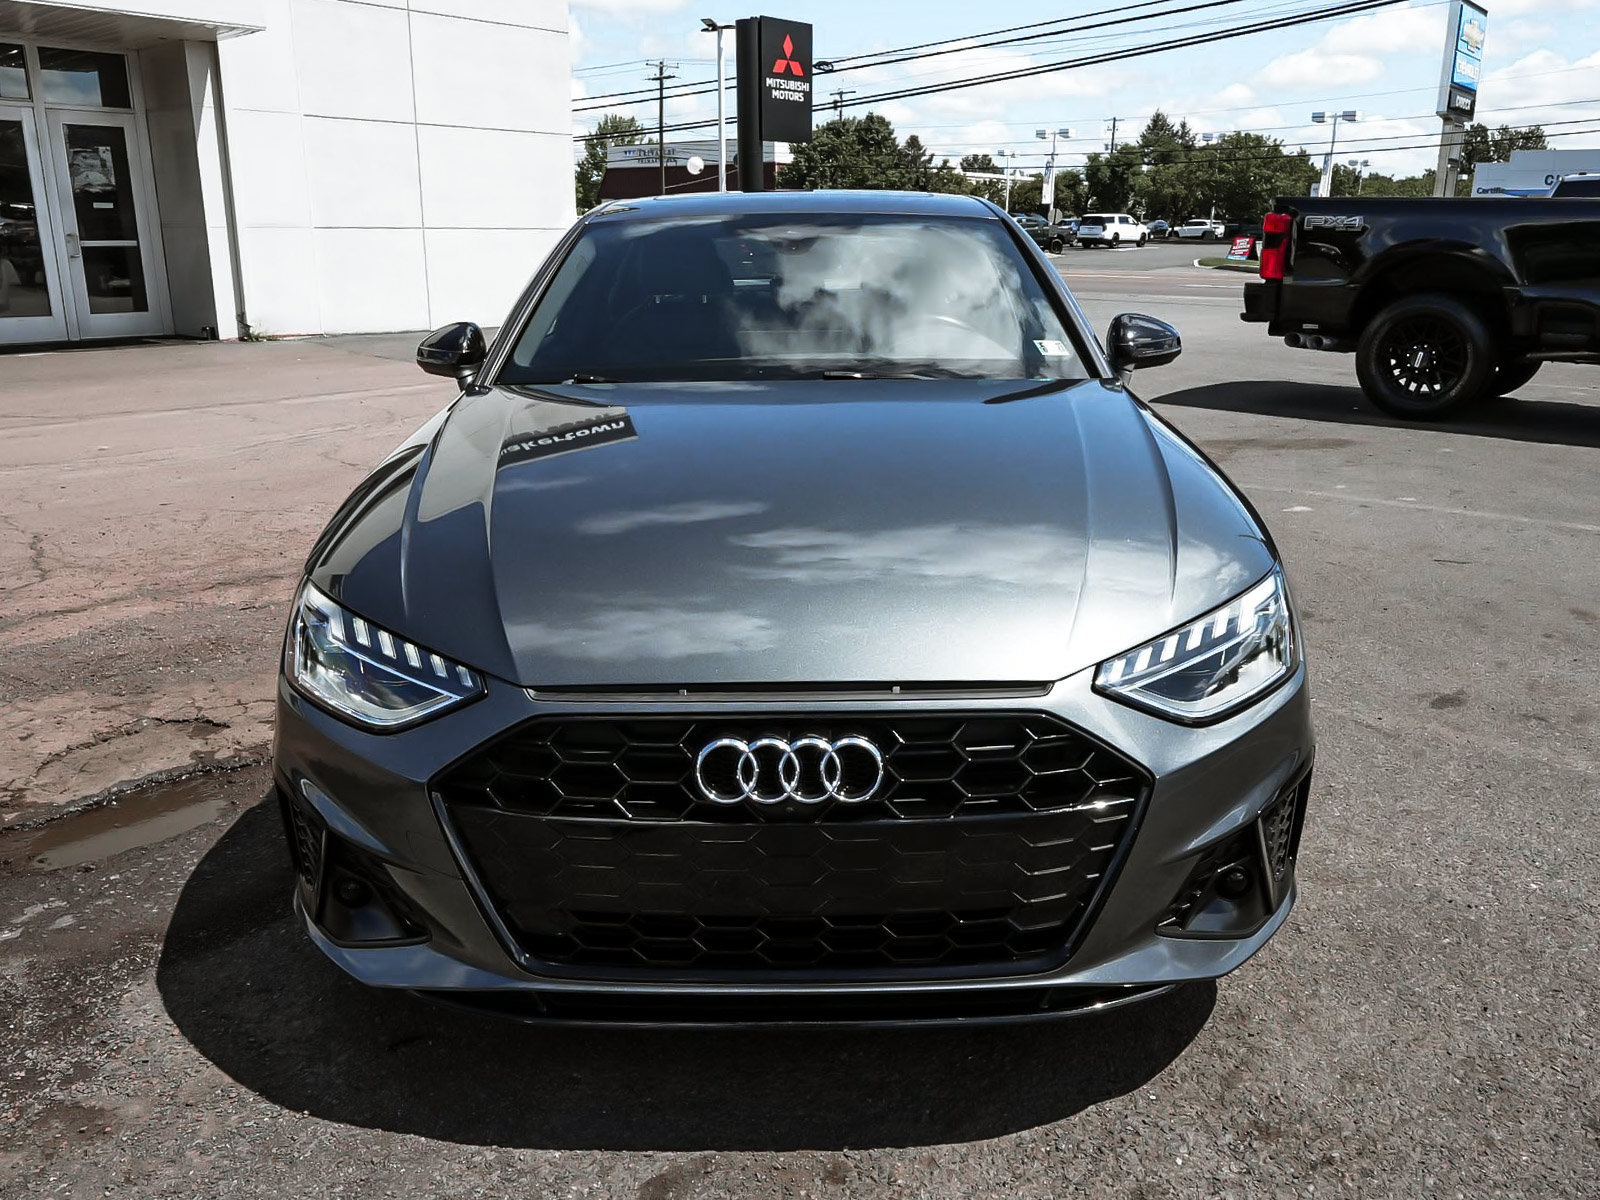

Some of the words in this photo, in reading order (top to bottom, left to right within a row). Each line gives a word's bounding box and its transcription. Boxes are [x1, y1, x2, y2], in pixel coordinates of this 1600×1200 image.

[765, 77, 810, 92] MITSUBISHI
[771, 89, 804, 102] MOTORS
[1304, 215, 1364, 230] FX4
